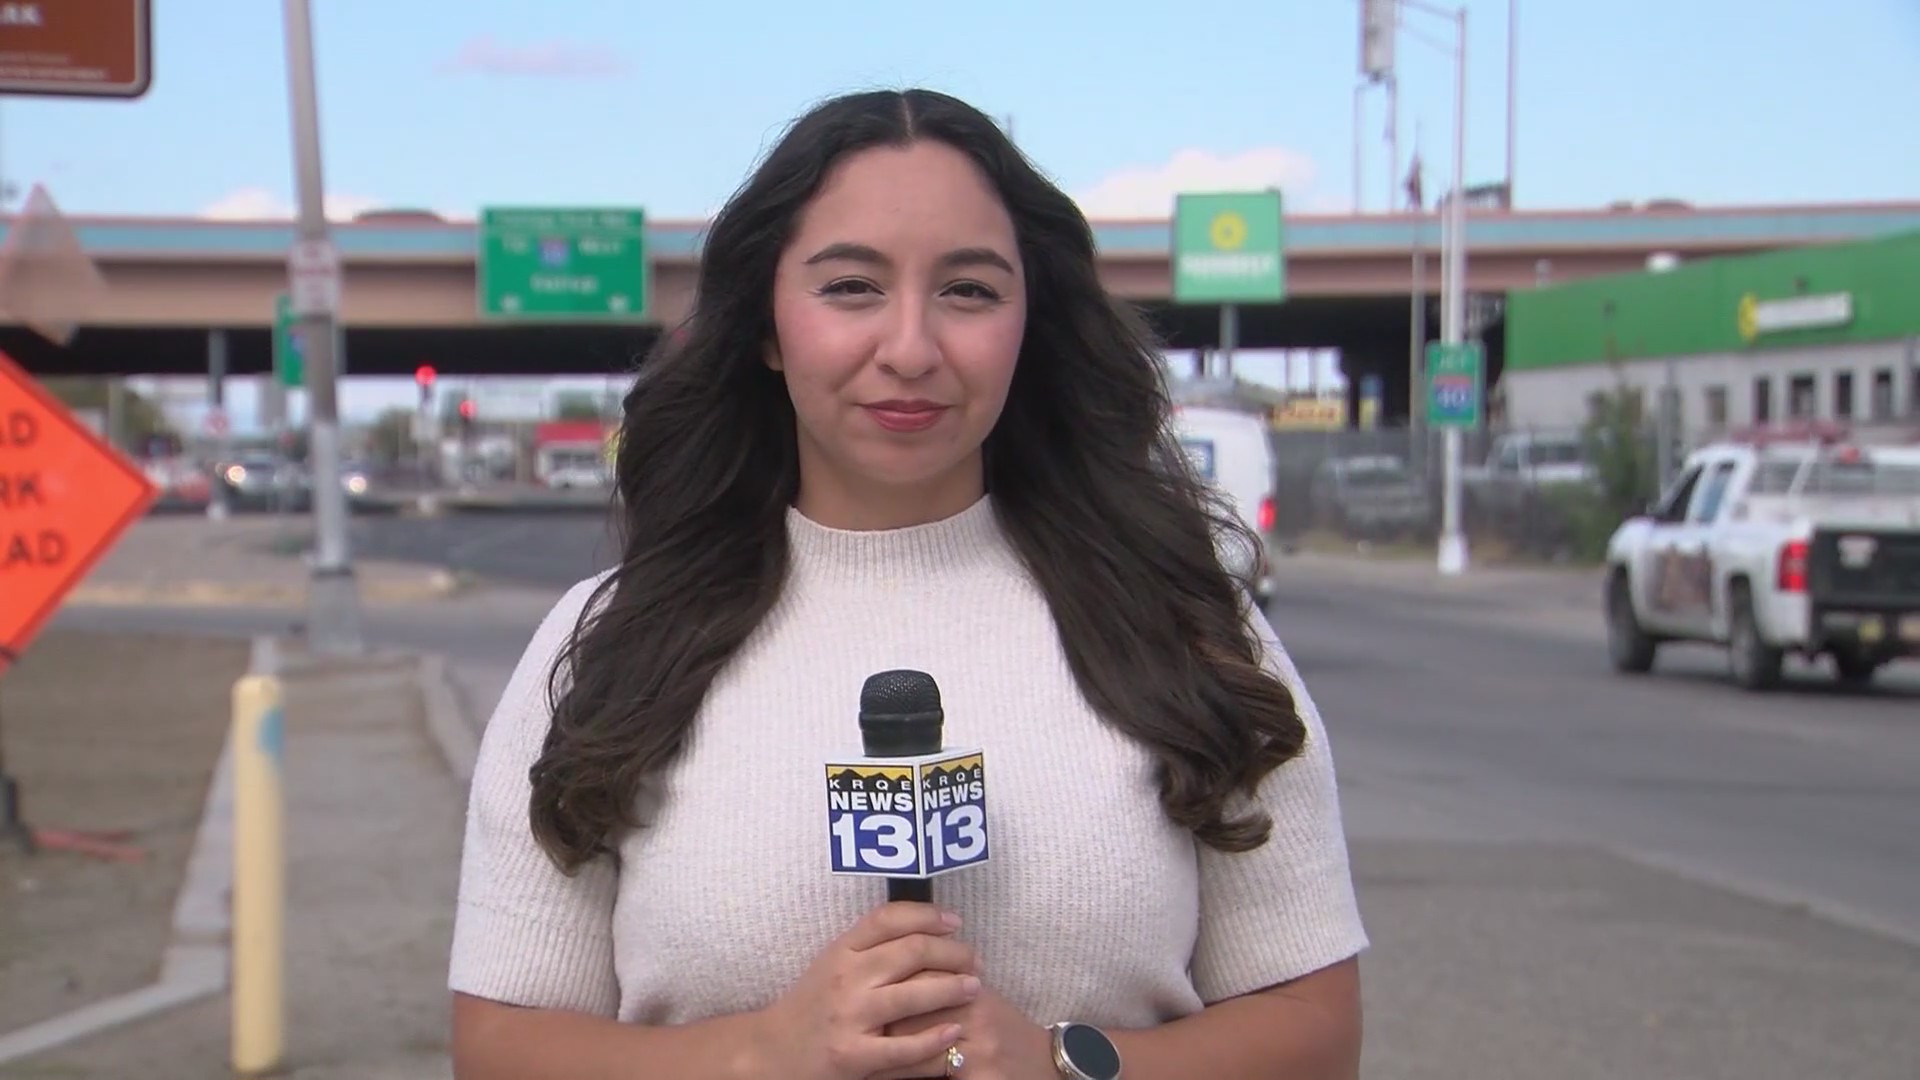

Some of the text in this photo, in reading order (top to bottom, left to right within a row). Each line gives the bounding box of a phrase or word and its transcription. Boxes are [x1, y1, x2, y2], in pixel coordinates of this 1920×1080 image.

[0, 411, 38, 446] D
[0, 530, 67, 569] AD
[829, 778, 912, 791] KRQE
[922, 768, 982, 789] KRQE
[830, 790, 914, 812] NEWS
[923, 780, 984, 811] NEWS
[832, 813, 917, 869] 13
[925, 804, 986, 868] 13
